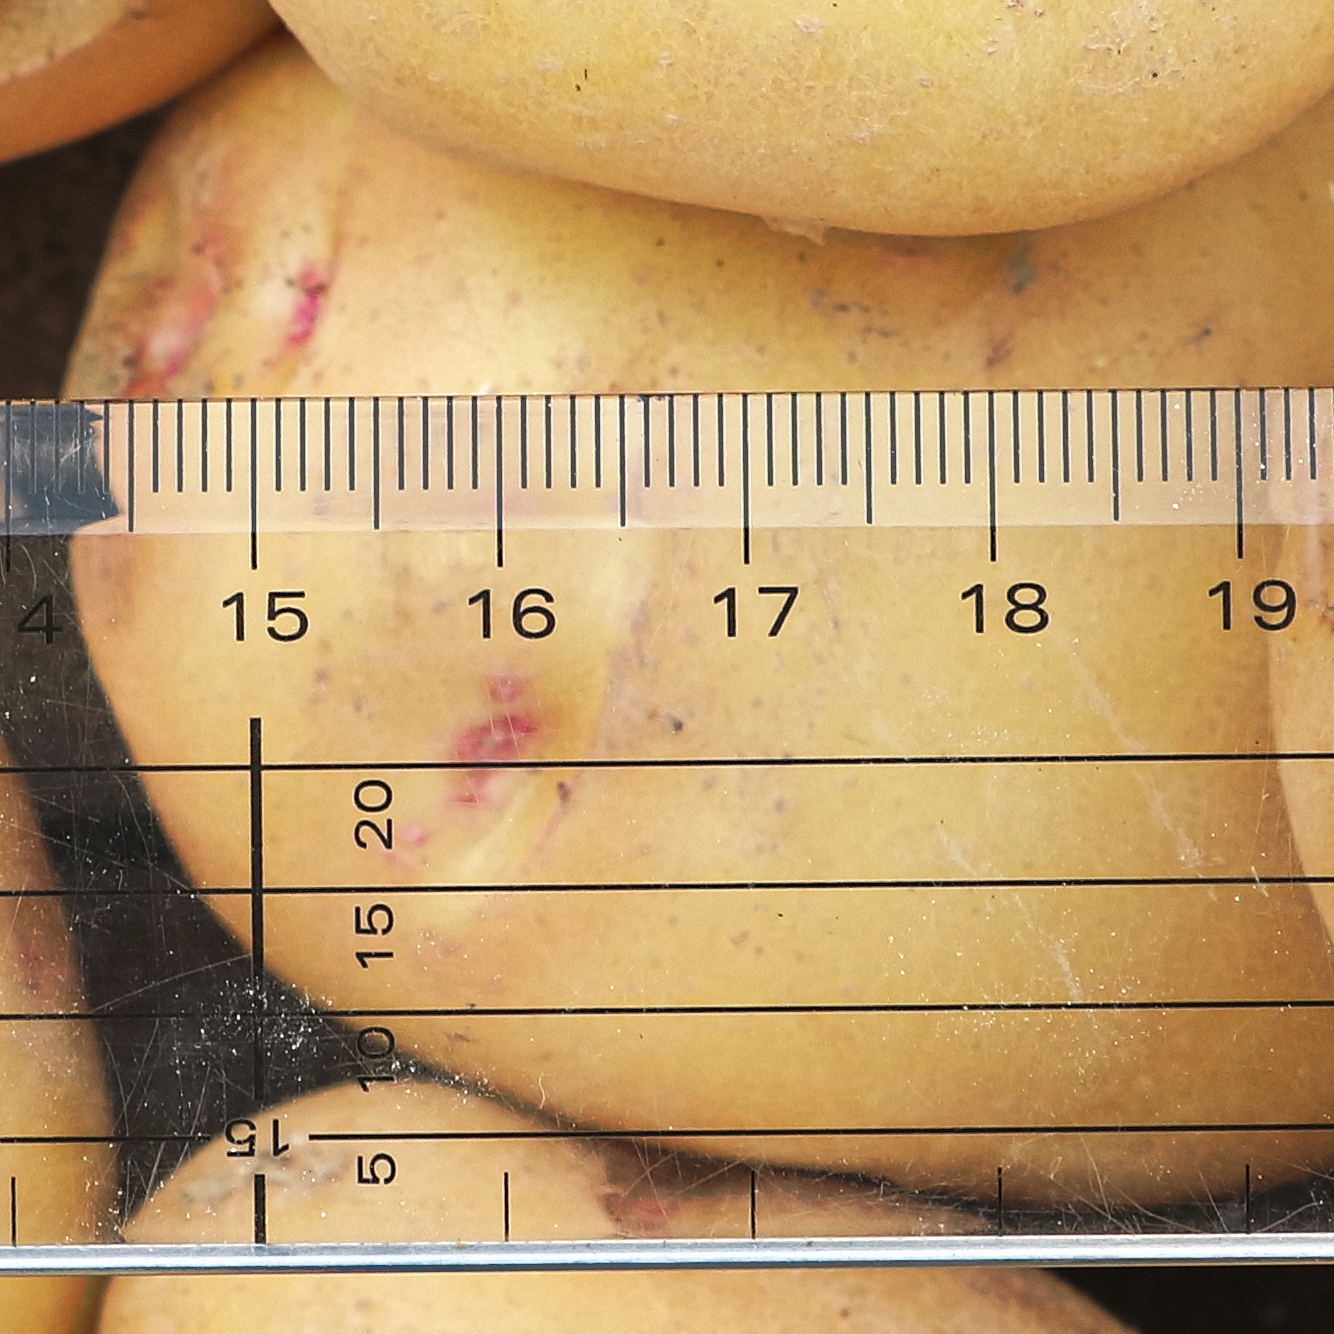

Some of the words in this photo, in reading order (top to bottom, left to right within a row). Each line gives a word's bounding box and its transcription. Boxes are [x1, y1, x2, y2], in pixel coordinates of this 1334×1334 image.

[223, 591, 308, 642] 15
[469, 589, 555, 639] 16
[714, 587, 798, 637] 17
[962, 583, 1048, 633] 18
[1209, 580, 1296, 631] 19
[354, 780, 392, 849] 20
[355, 904, 393, 968] 15
[356, 1026, 396, 1092] 10
[224, 1119, 290, 1157] 15
[358, 1153, 396, 1184] 5
